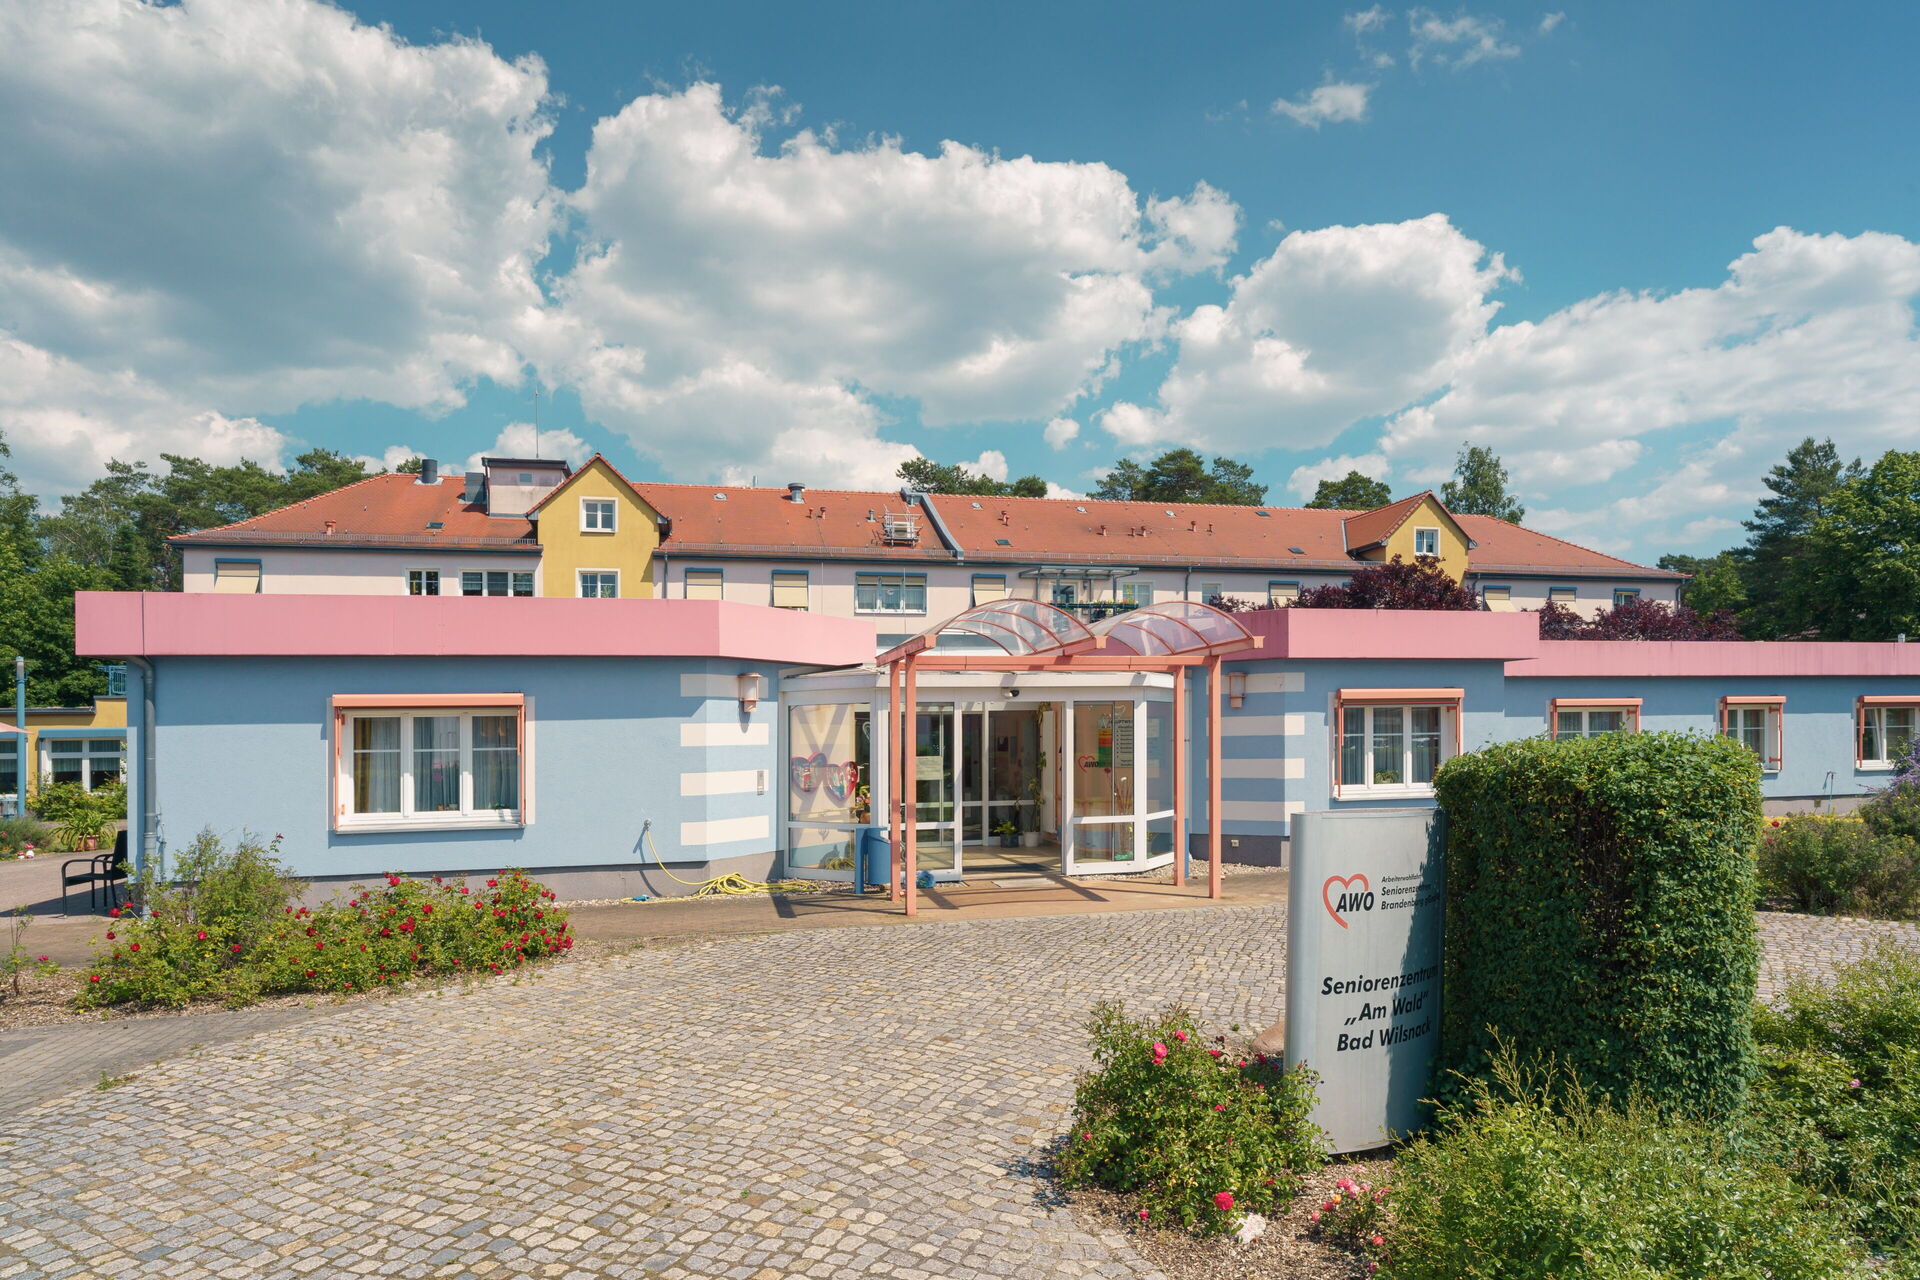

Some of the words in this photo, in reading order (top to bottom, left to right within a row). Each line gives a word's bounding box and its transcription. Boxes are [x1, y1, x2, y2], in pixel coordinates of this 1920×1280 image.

[1336, 892, 1374, 912] AWO
[1321, 964, 1439, 995] Seniorenzentrum
[1337, 1030, 1374, 1051] Bad
[1379, 1016, 1432, 1046] Wilsnack
